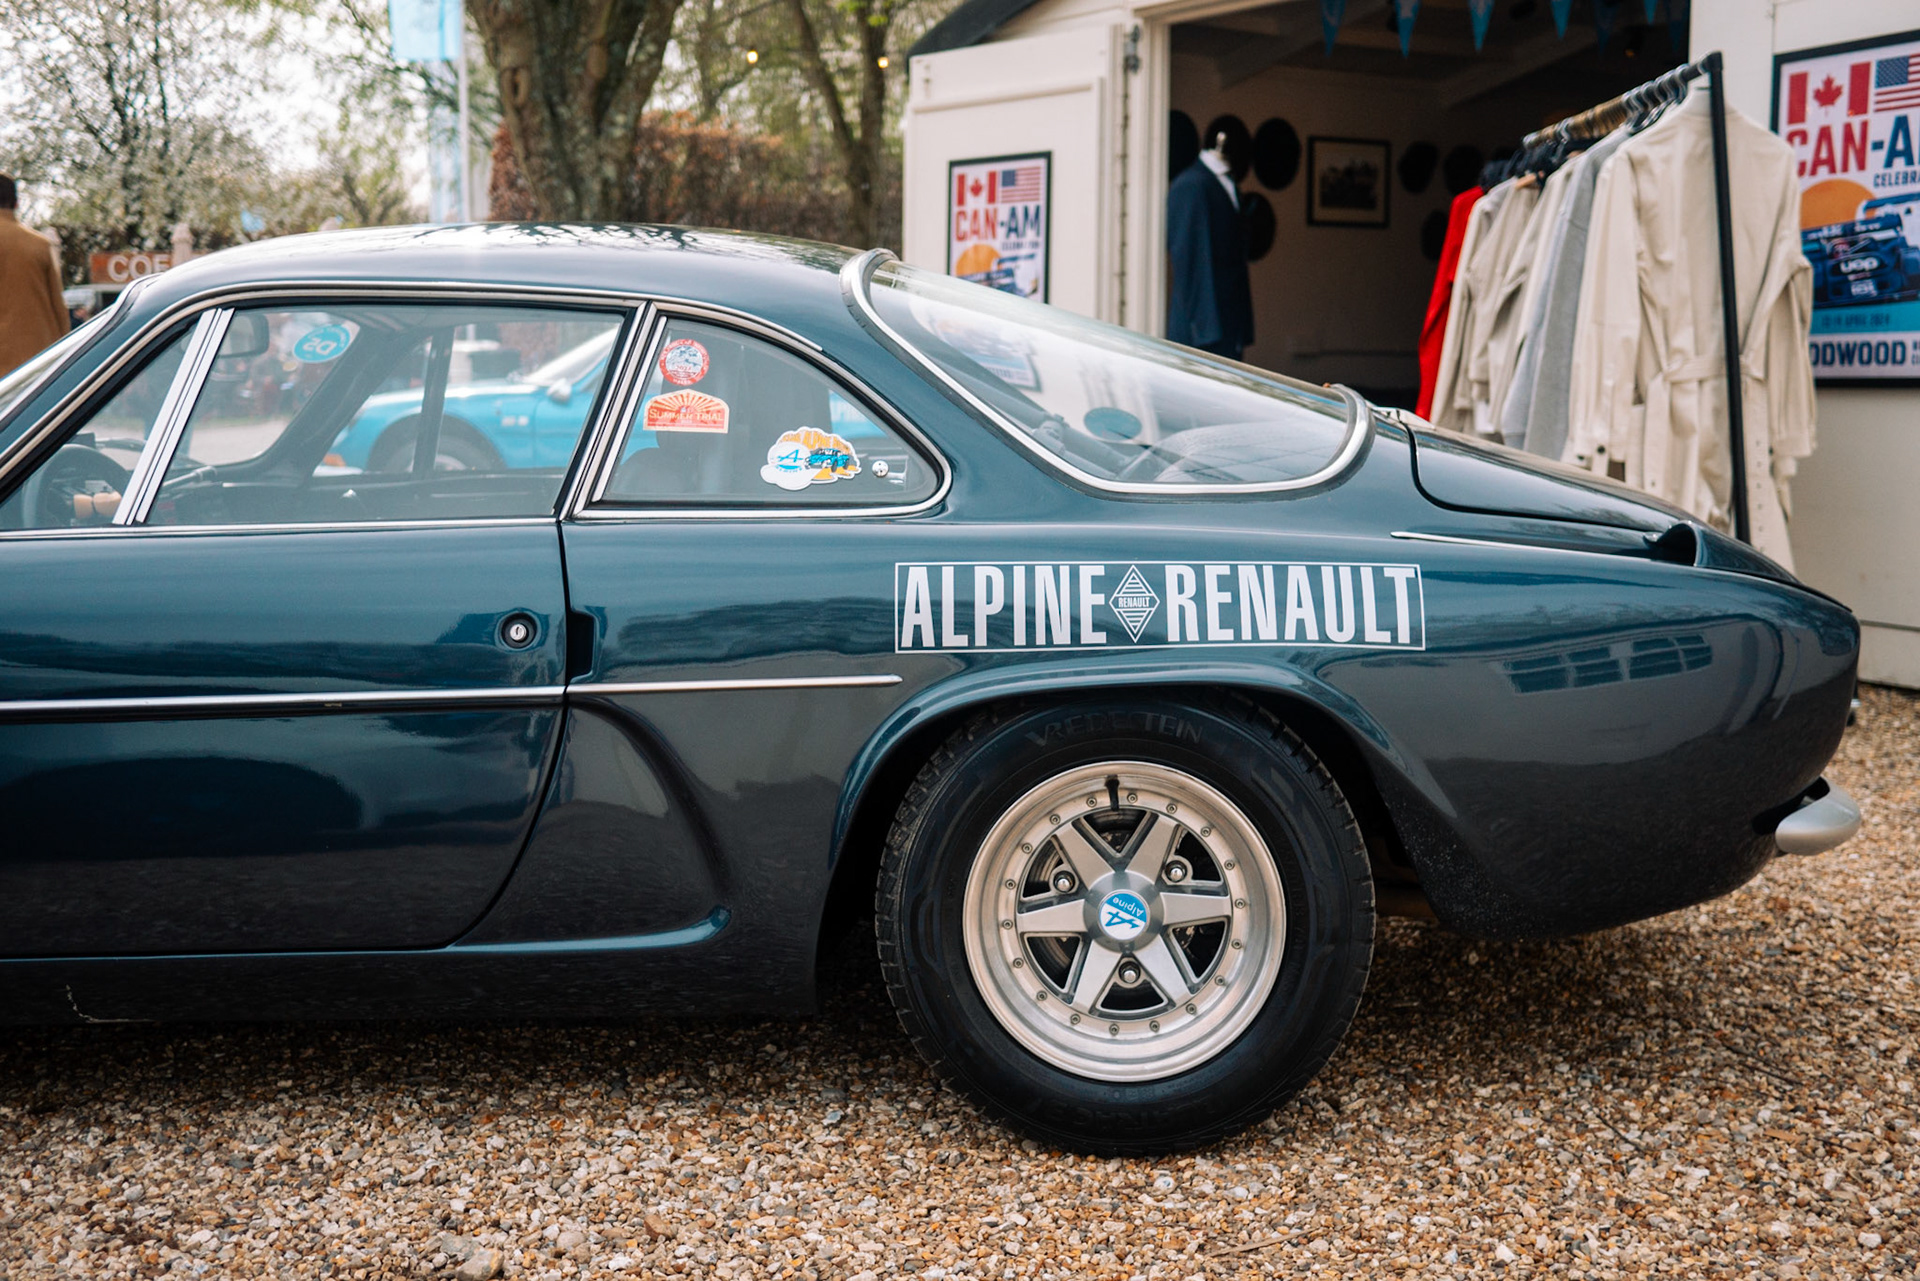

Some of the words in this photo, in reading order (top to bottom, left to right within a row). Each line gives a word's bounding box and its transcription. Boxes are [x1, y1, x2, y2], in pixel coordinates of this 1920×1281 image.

[1786, 114, 1920, 178] CAN-A
[956, 204, 1041, 242] CAN-AM
[649, 408, 693, 421] SUMMER
[695, 411, 724, 422] TRIAL
[900, 565, 1107, 648] ALPINE
[1164, 564, 1418, 645] RENAULT
[1118, 597, 1150, 608] RENAULT
[1112, 896, 1145, 918] Alpine
